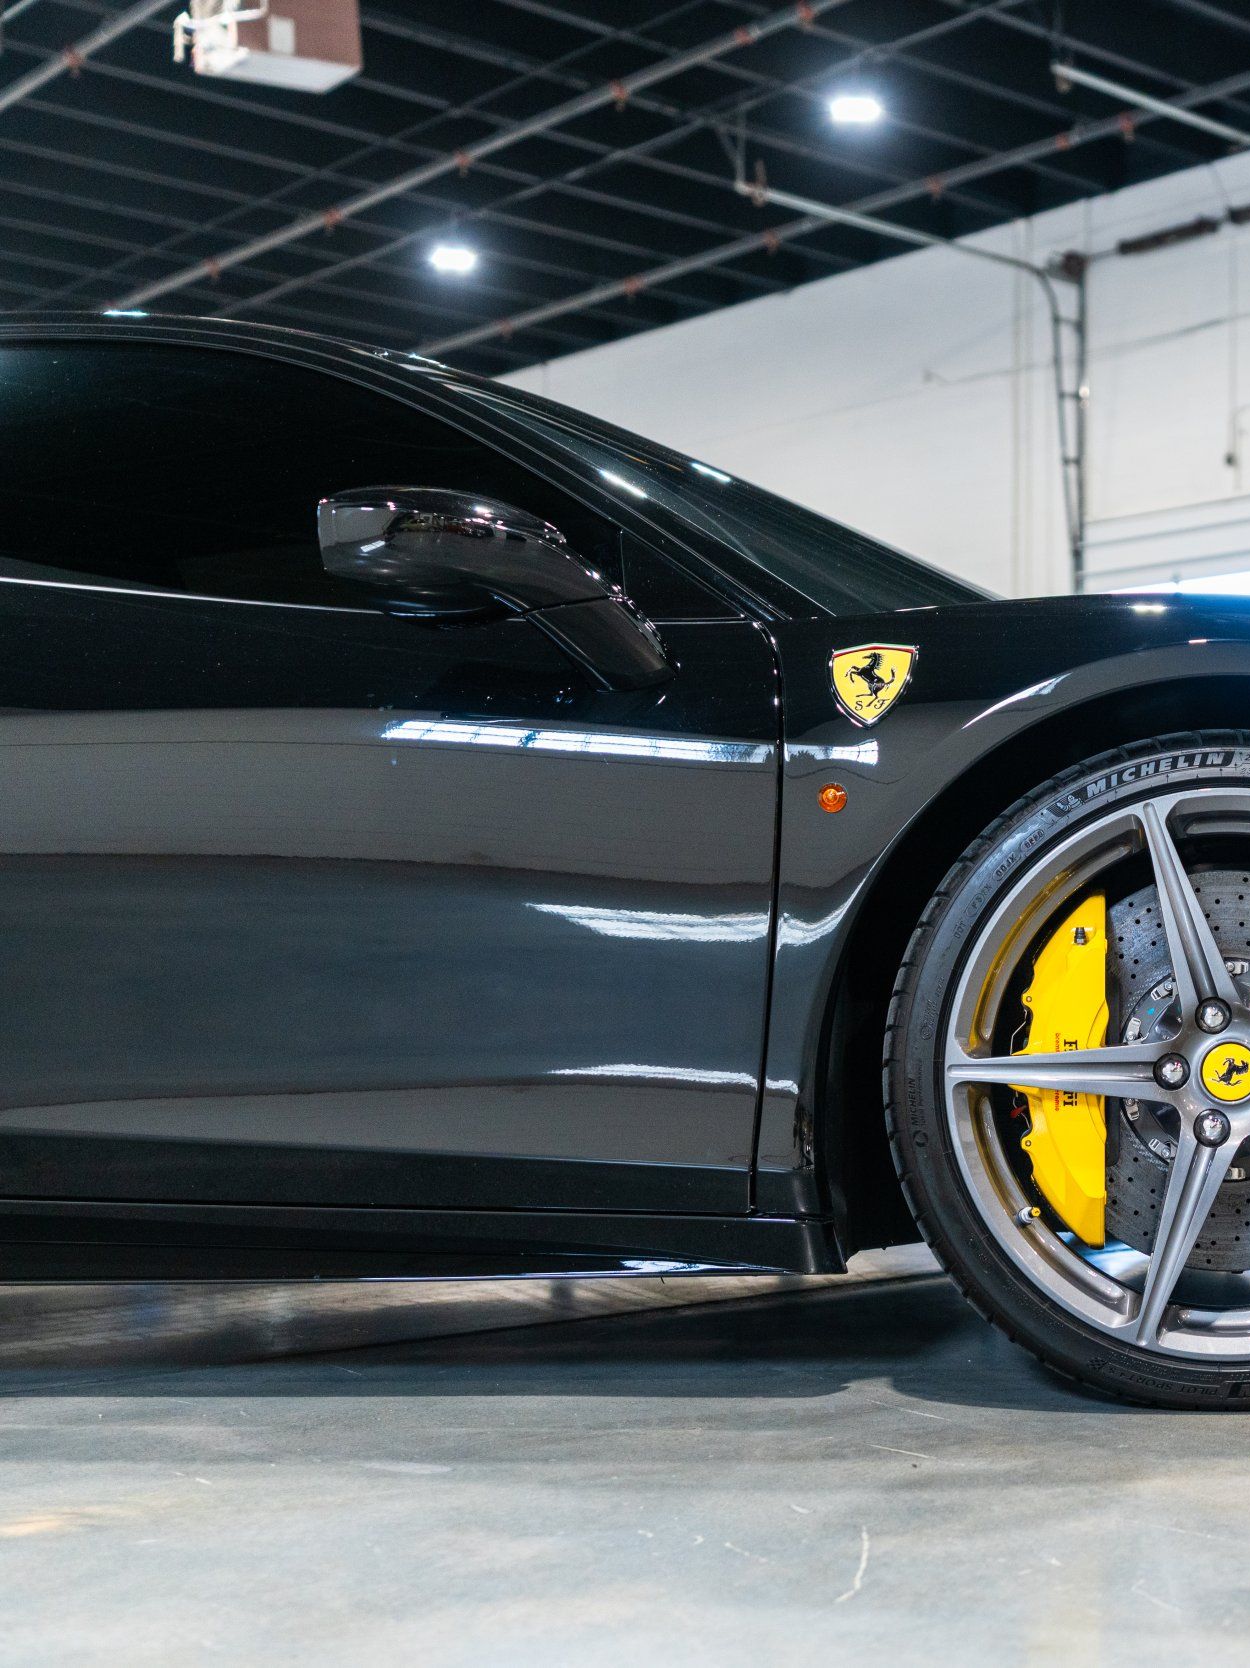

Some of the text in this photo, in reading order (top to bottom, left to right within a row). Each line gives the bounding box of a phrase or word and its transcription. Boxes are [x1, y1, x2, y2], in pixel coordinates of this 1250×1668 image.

[1086, 752, 1226, 799] MICHELIN
[907, 1078, 921, 1127] MICHELIN
[1127, 1375, 1174, 1391] SPORT
[1180, 1386, 1218, 1396] PILOT
